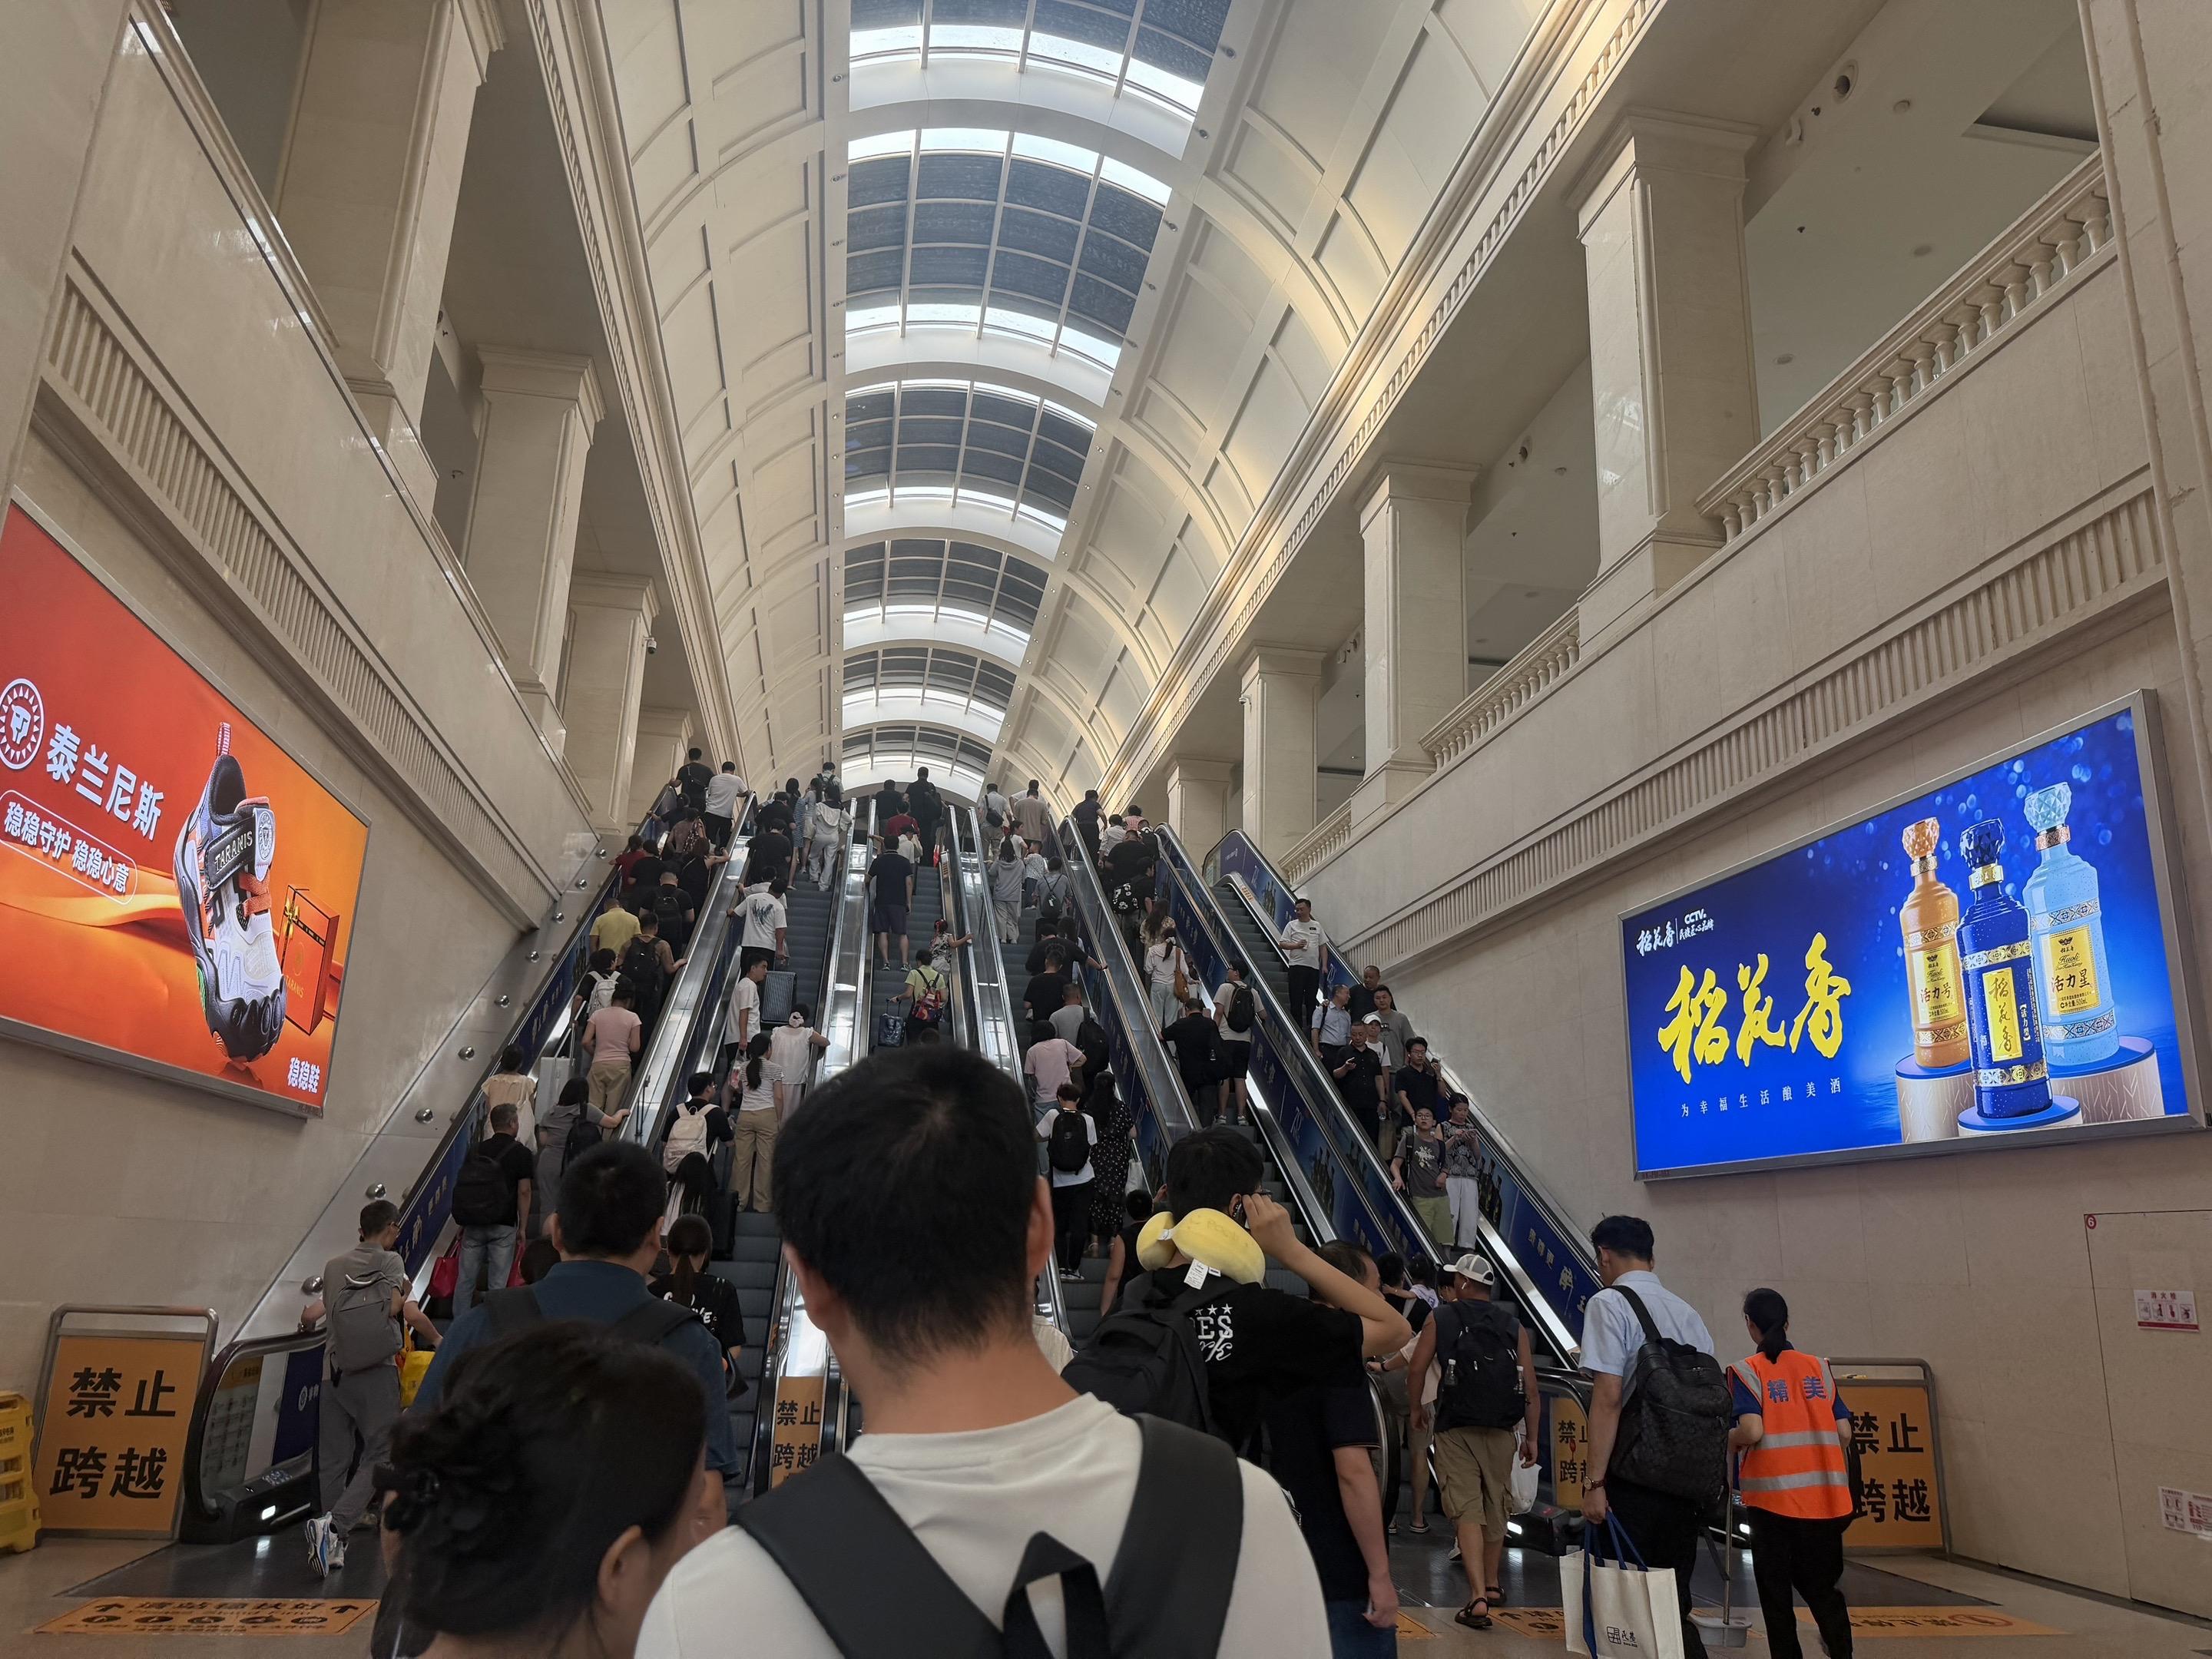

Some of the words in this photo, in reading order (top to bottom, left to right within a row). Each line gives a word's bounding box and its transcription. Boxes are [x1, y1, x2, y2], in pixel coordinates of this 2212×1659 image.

[47, 723, 164, 841] 泰兰尼斯
[4, 801, 71, 860] 稳稳守护
[72, 839, 130, 893] 稳稳心意
[214, 830, 253, 873] TARANIS
[1636, 921, 1675, 956] 稻花香
[1921, 982, 1952, 1002] 活力号
[2051, 969, 2091, 993] 活力星
[1657, 932, 1852, 1084] 稻花香
[1988, 977, 2014, 1052] 稻花香
[287, 1057, 320, 1094] 稳稳鞋
[1681, 1077, 1842, 1118] 为幸福生活酿美酒
[66, 1366, 176, 1419] 禁止
[1767, 1376, 1826, 1403] 精美
[777, 1399, 820, 1426] 禁止
[1848, 1411, 1925, 1455] 禁止
[49, 1445, 167, 1499] 跨越
[773, 1442, 818, 1469] 跨越
